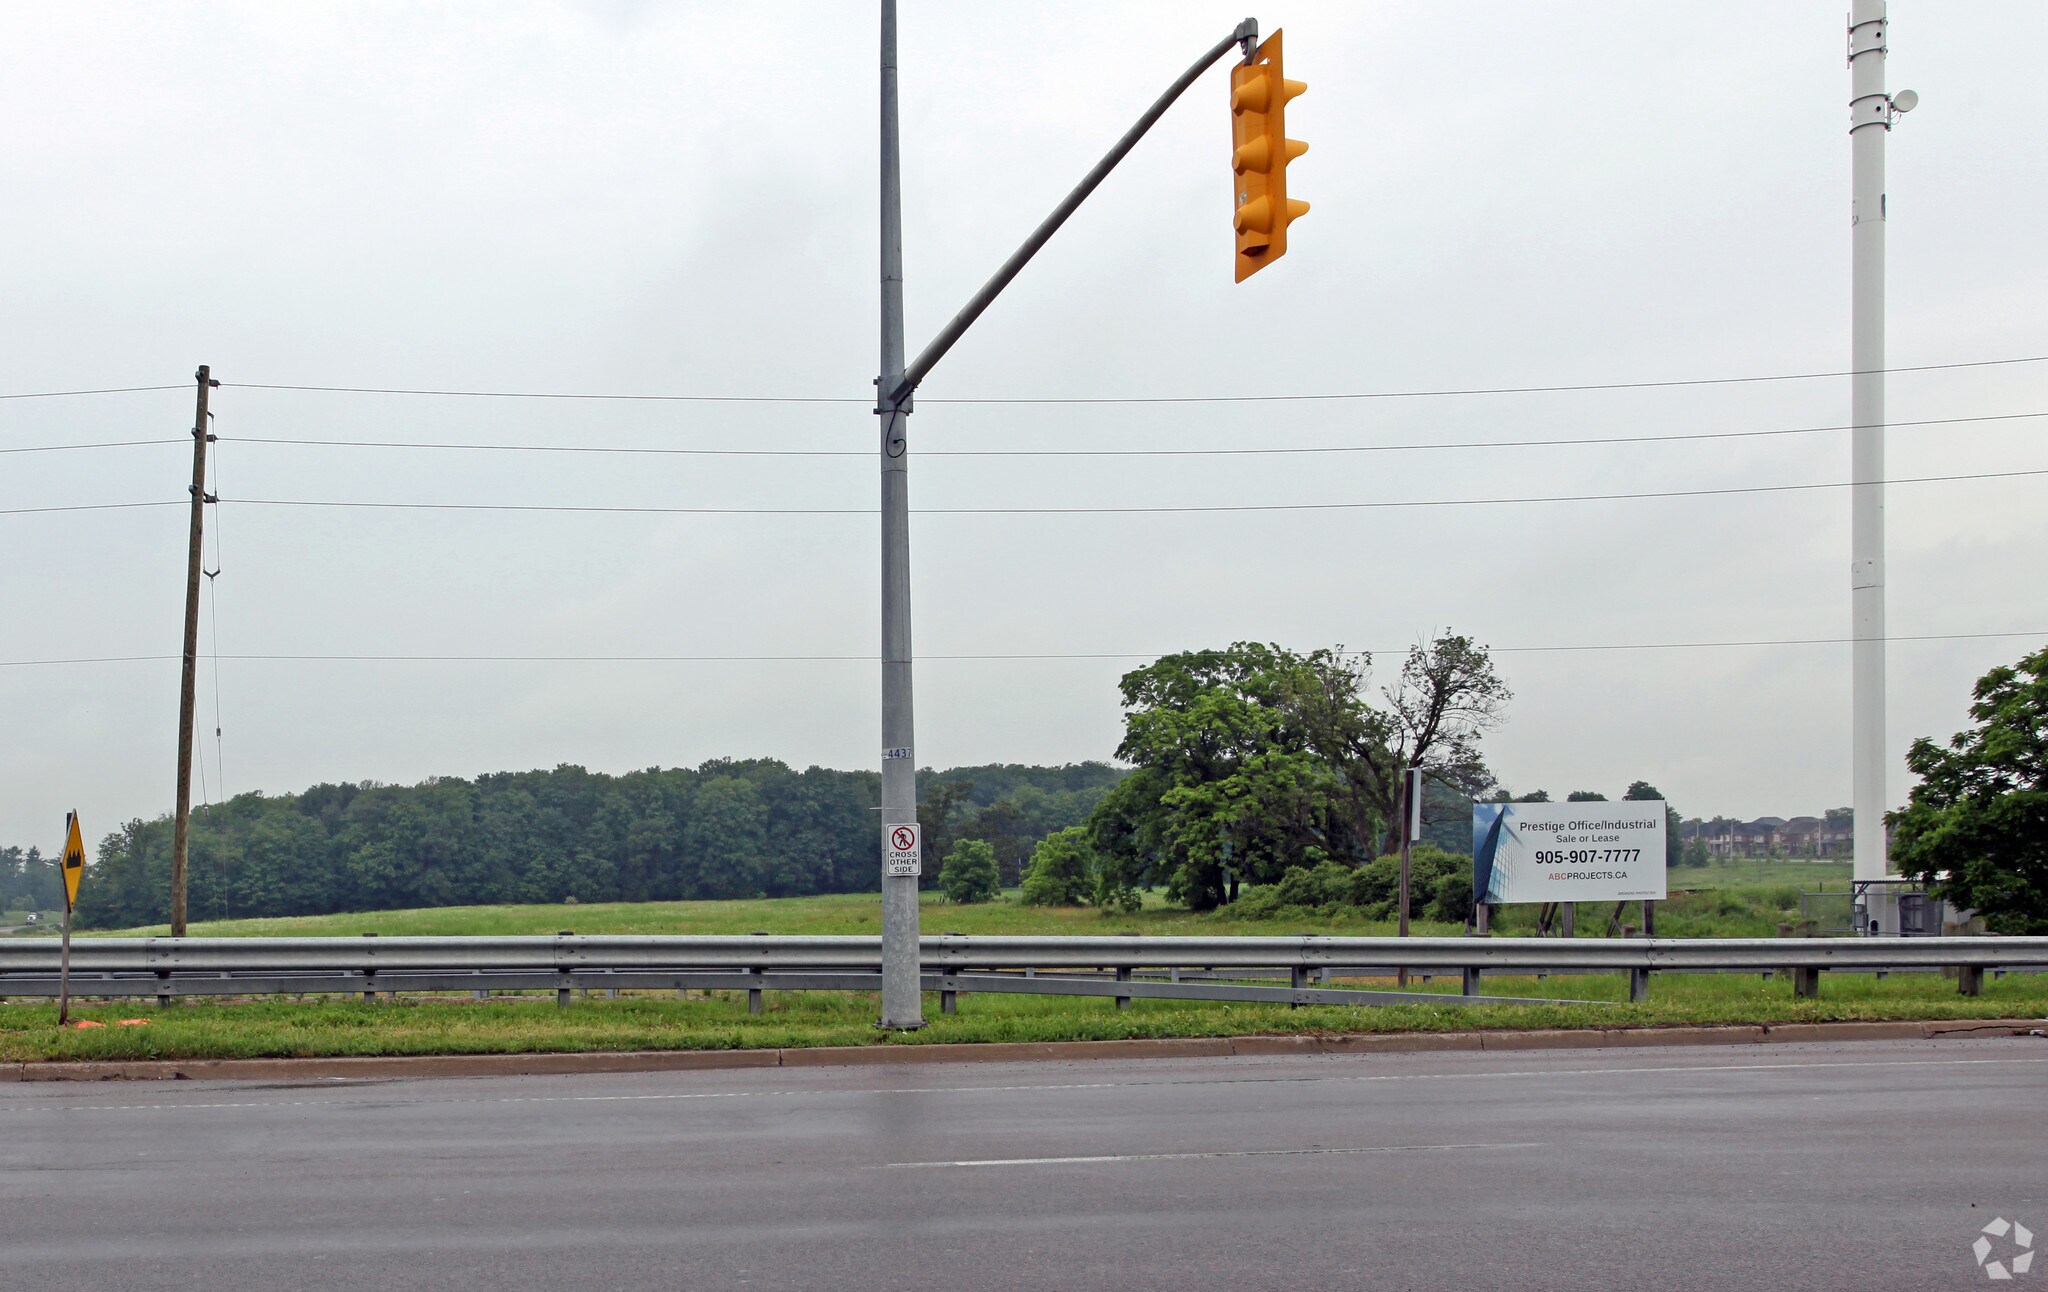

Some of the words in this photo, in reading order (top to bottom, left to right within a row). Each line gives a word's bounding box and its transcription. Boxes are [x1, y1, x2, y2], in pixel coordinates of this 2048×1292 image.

[1520, 821, 1565, 833] Prestige
[1568, 819, 1656, 831] Office/Industrial
[1556, 834, 1576, 843] Sale
[1579, 835, 1589, 843] or
[1592, 834, 1620, 843] Lease
[1535, 849, 1641, 864] 905-907-7777
[1548, 871, 1628, 880] ABCPROJECTS.CA
